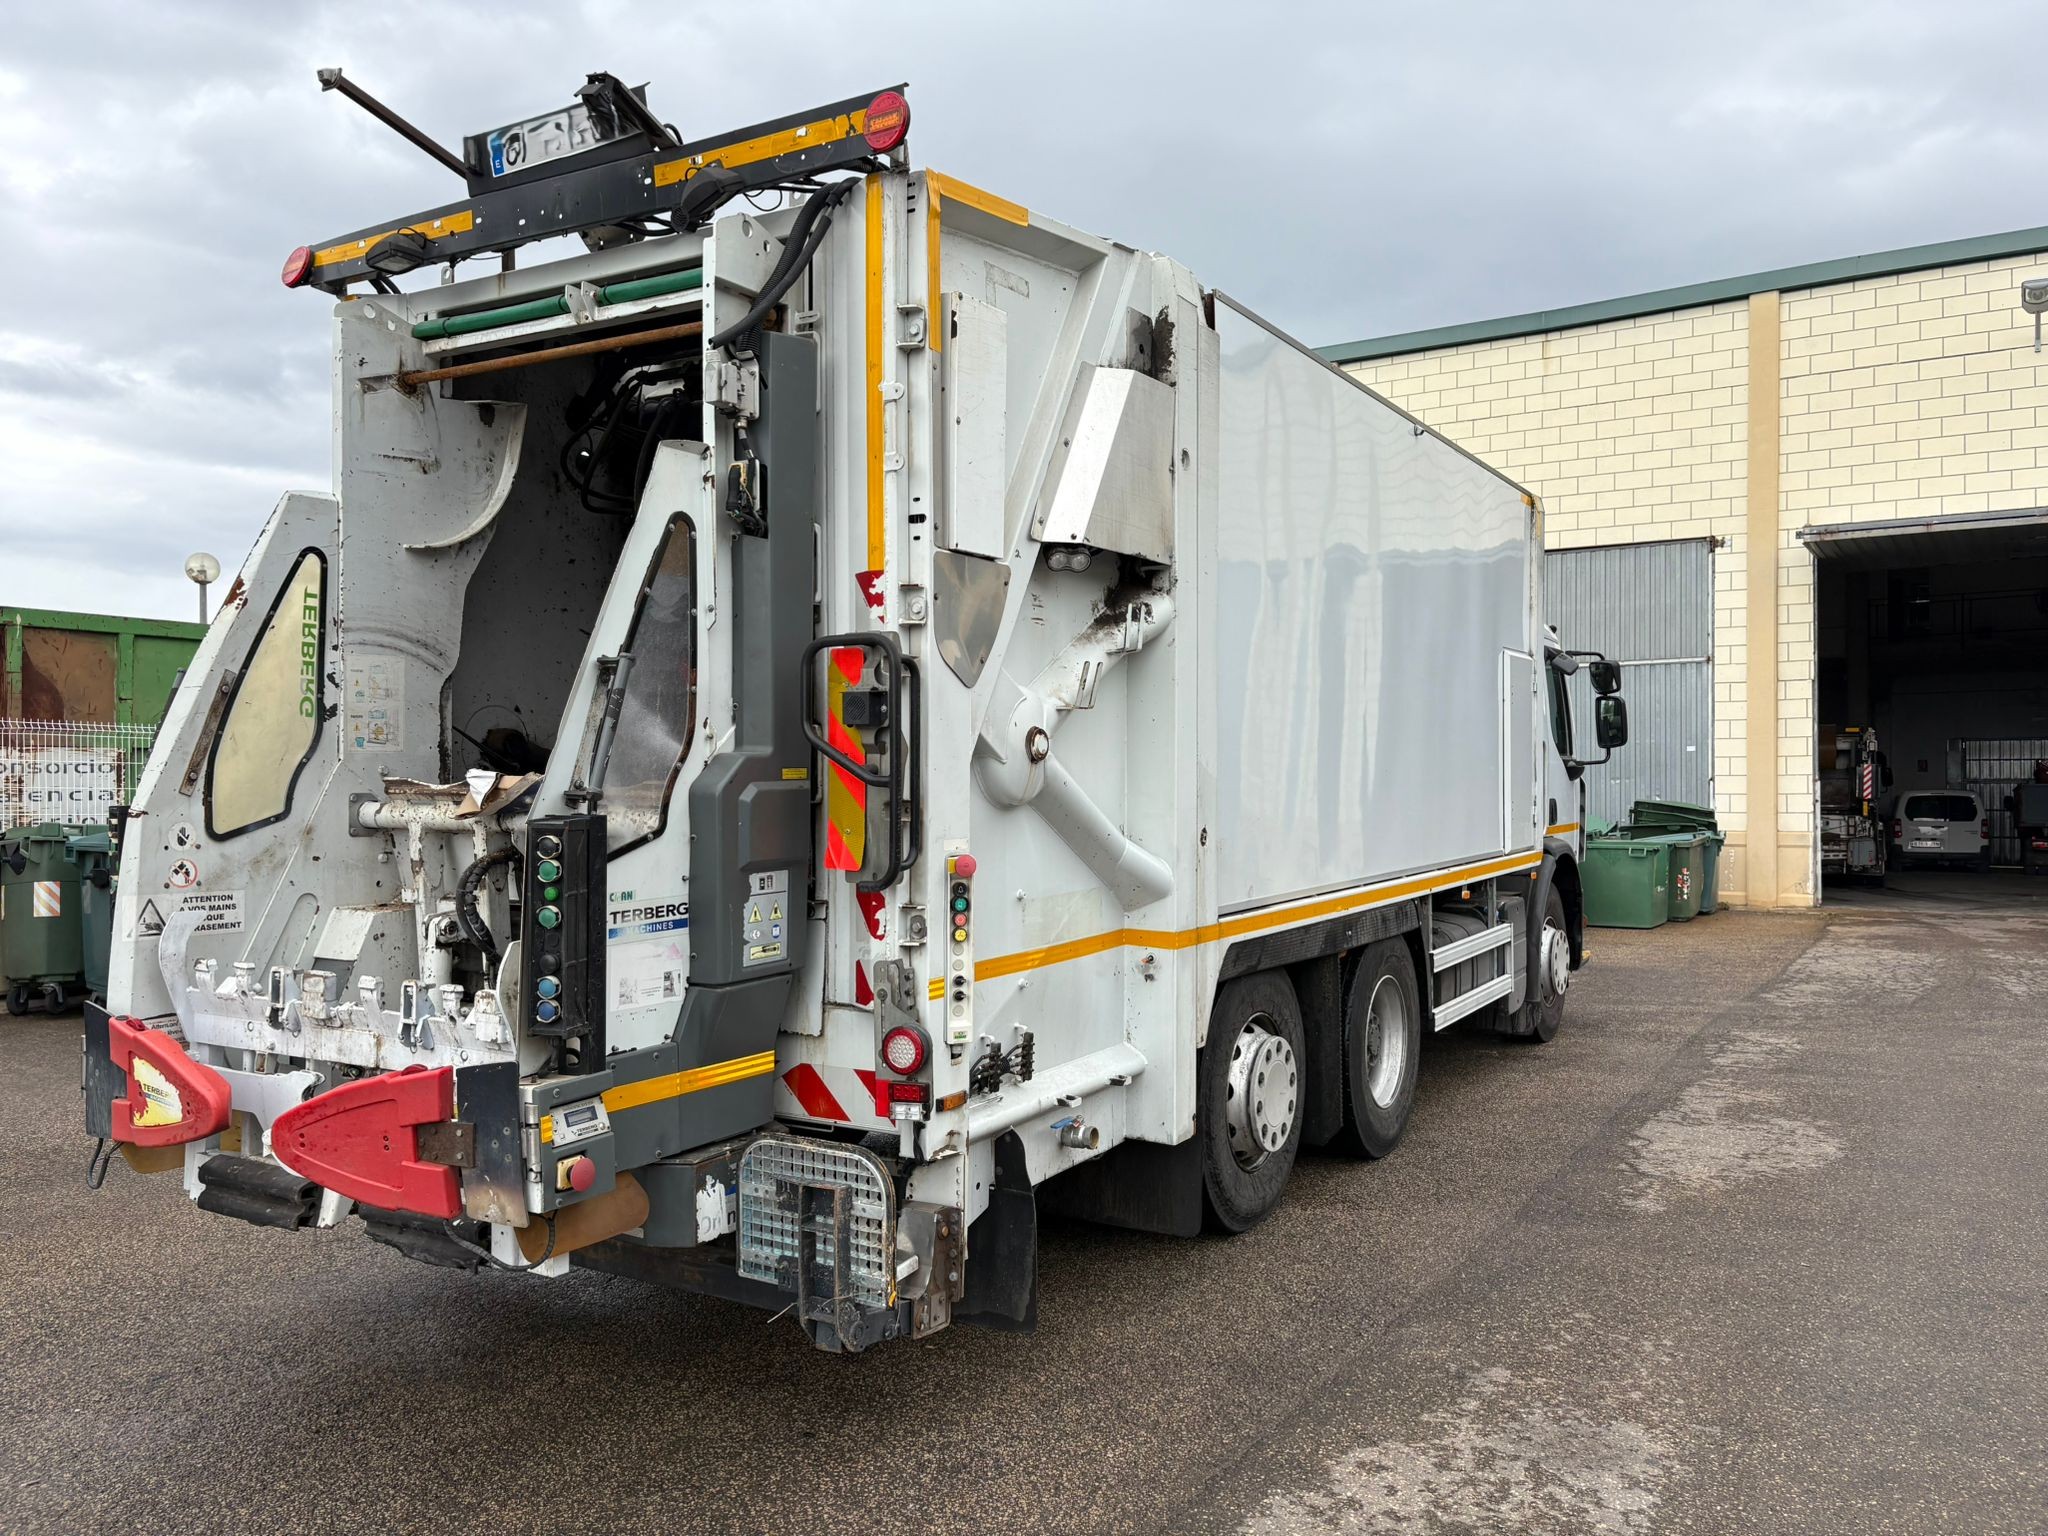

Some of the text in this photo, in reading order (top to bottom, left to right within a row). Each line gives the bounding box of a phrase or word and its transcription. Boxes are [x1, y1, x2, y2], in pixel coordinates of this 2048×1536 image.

[495, 159, 501, 169] E
[182, 894, 234, 904] ATTENTION
[609, 890, 633, 902] CAN
[208, 903, 237, 912] MAINS
[203, 913, 225, 922] QUE
[609, 902, 689, 925] TERBERG
[627, 921, 674, 934] ACHINES
